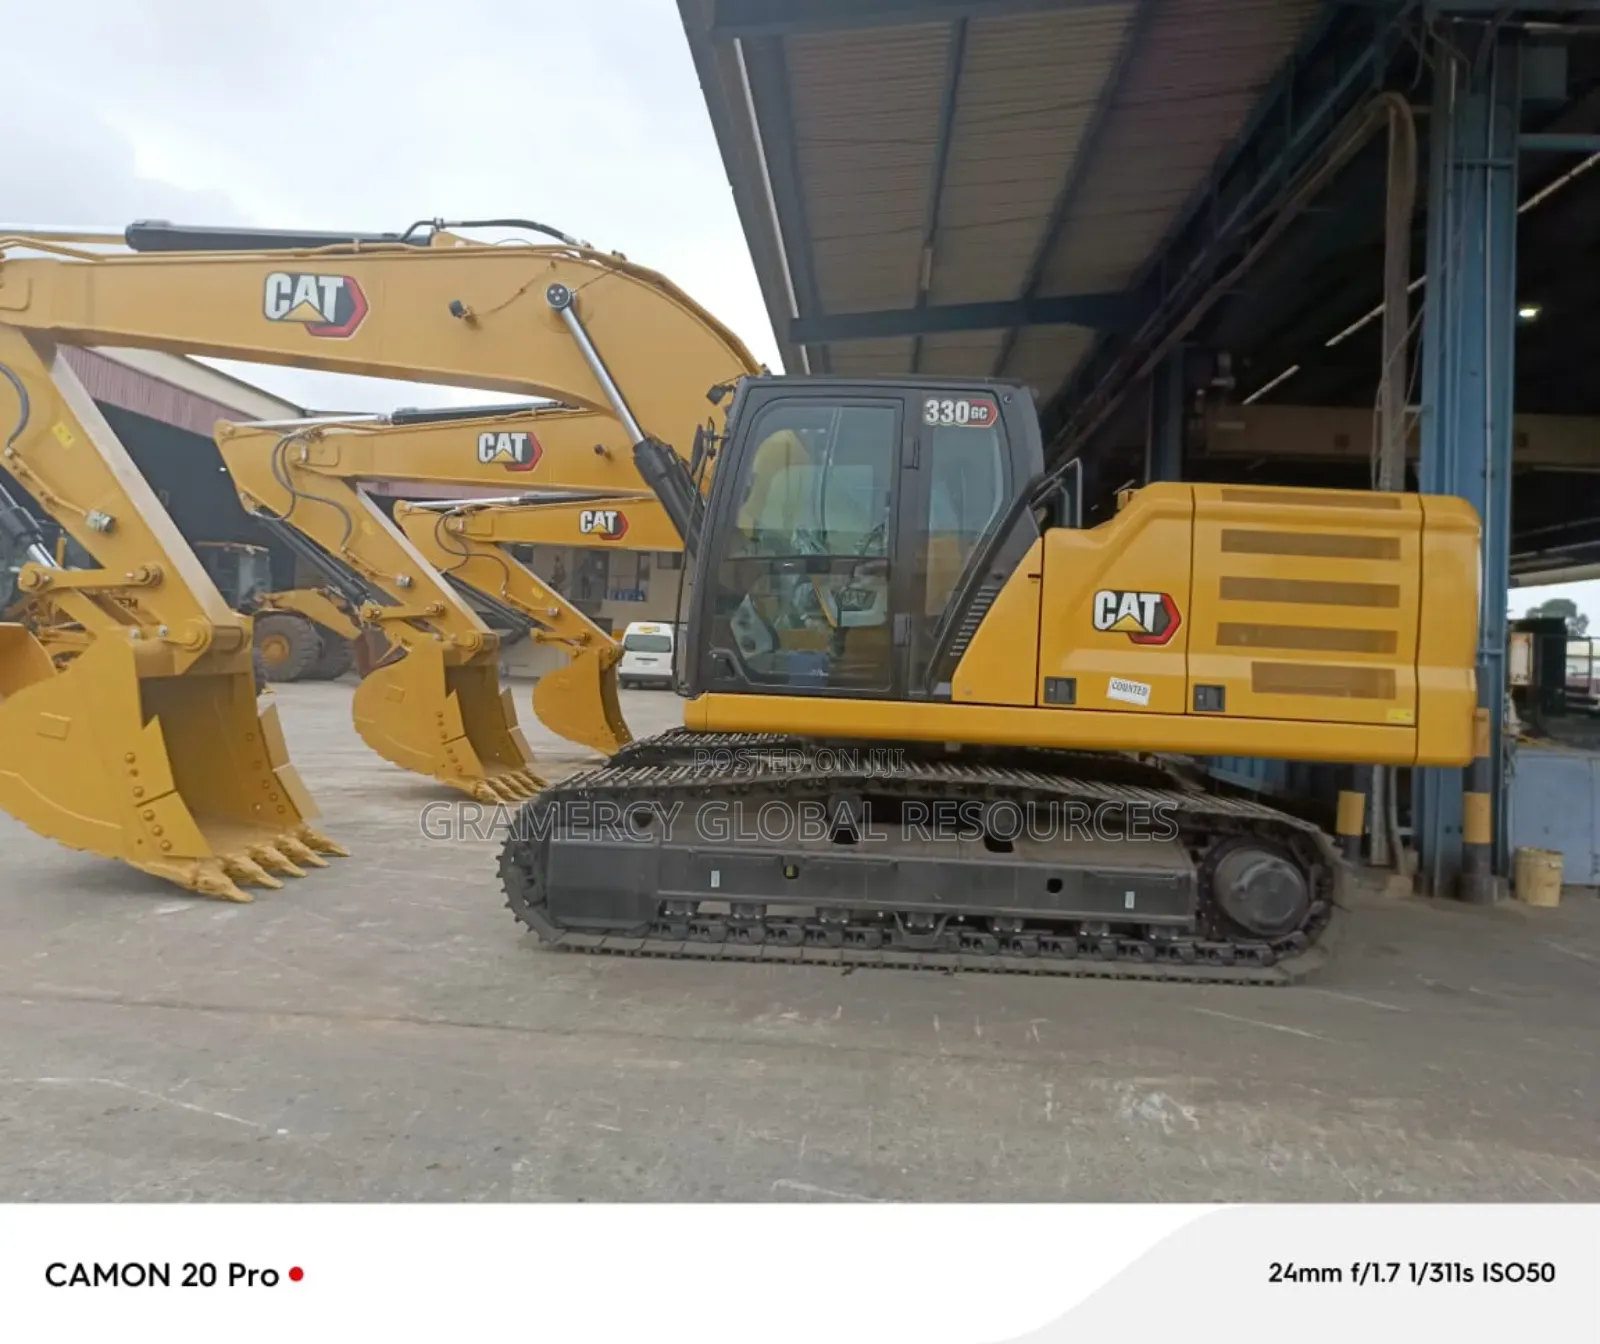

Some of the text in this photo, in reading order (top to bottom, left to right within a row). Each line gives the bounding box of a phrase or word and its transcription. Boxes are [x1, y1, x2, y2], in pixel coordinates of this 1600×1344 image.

[264, 272, 344, 323] CAT
[925, 399, 988, 424] 330 GC
[478, 431, 528, 463] CAT
[580, 510, 617, 534] CAT
[1093, 589, 1162, 633] CAT
